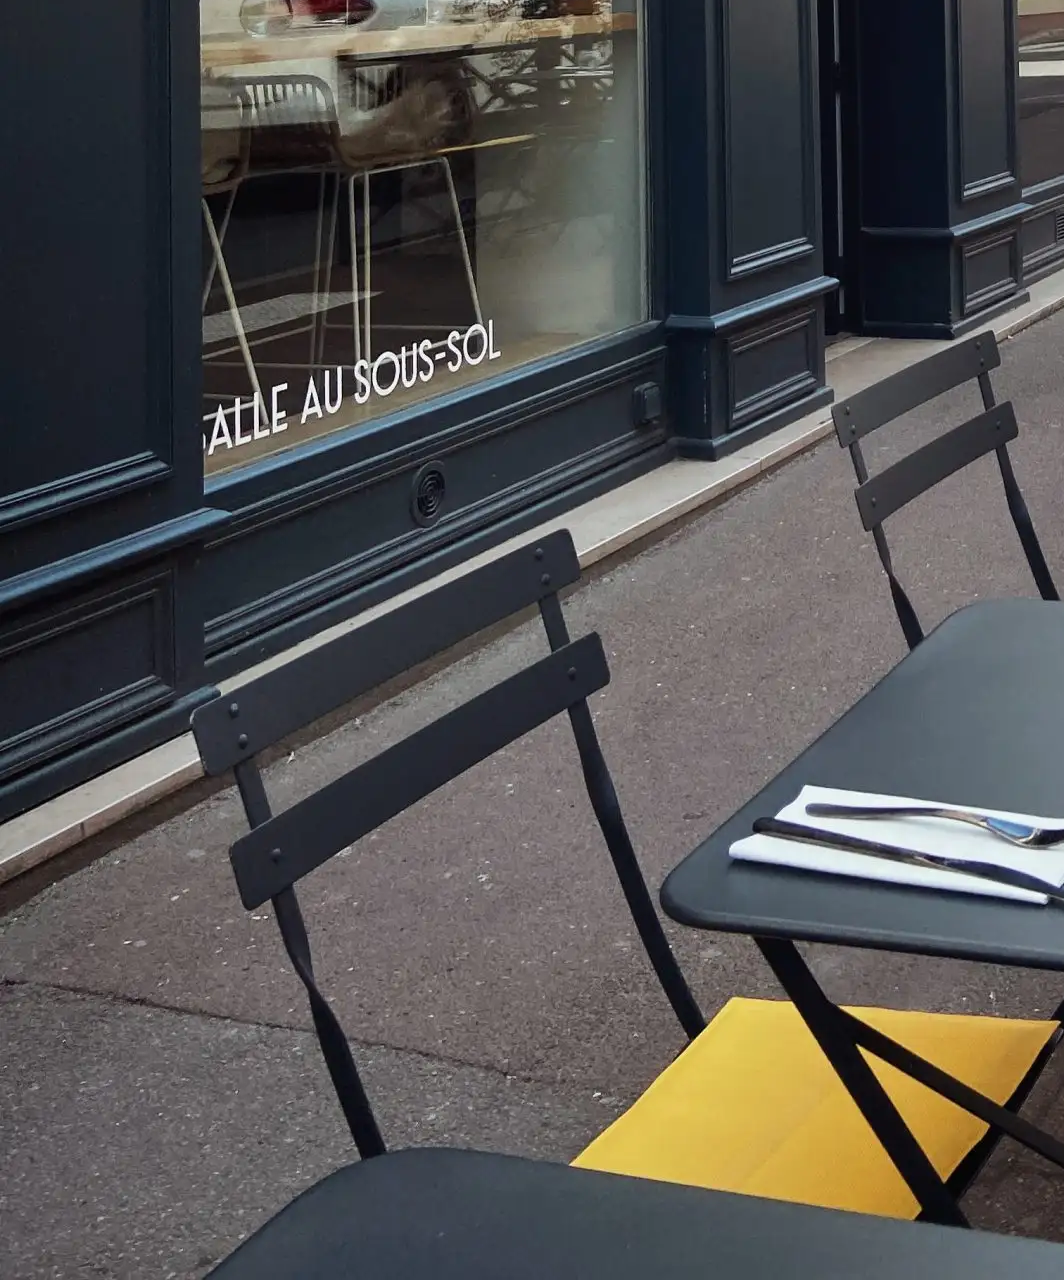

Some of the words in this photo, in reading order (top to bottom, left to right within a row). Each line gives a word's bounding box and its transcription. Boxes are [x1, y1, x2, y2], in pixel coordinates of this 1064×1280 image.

[202, 382, 289, 456] ALLE
[300, 365, 344, 424] AU
[353, 319, 502, 405] SOUS-SOL
